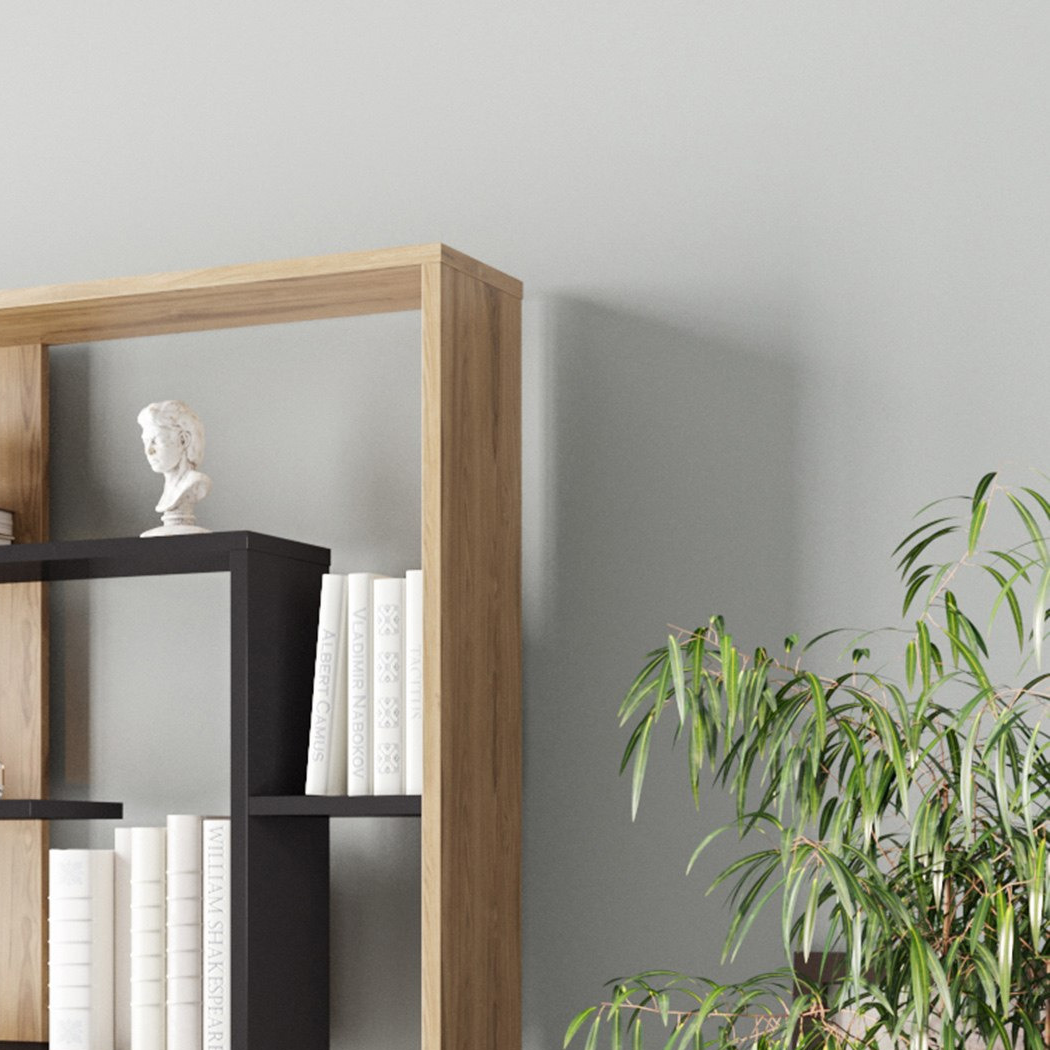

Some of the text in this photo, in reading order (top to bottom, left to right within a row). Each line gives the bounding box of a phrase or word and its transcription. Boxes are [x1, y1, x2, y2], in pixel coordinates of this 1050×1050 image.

[312, 628, 337, 763] ALBERT CAMUS
[351, 607, 367, 779] VLADIMIR NABOKOV
[208, 825, 224, 913] WILLIAM
